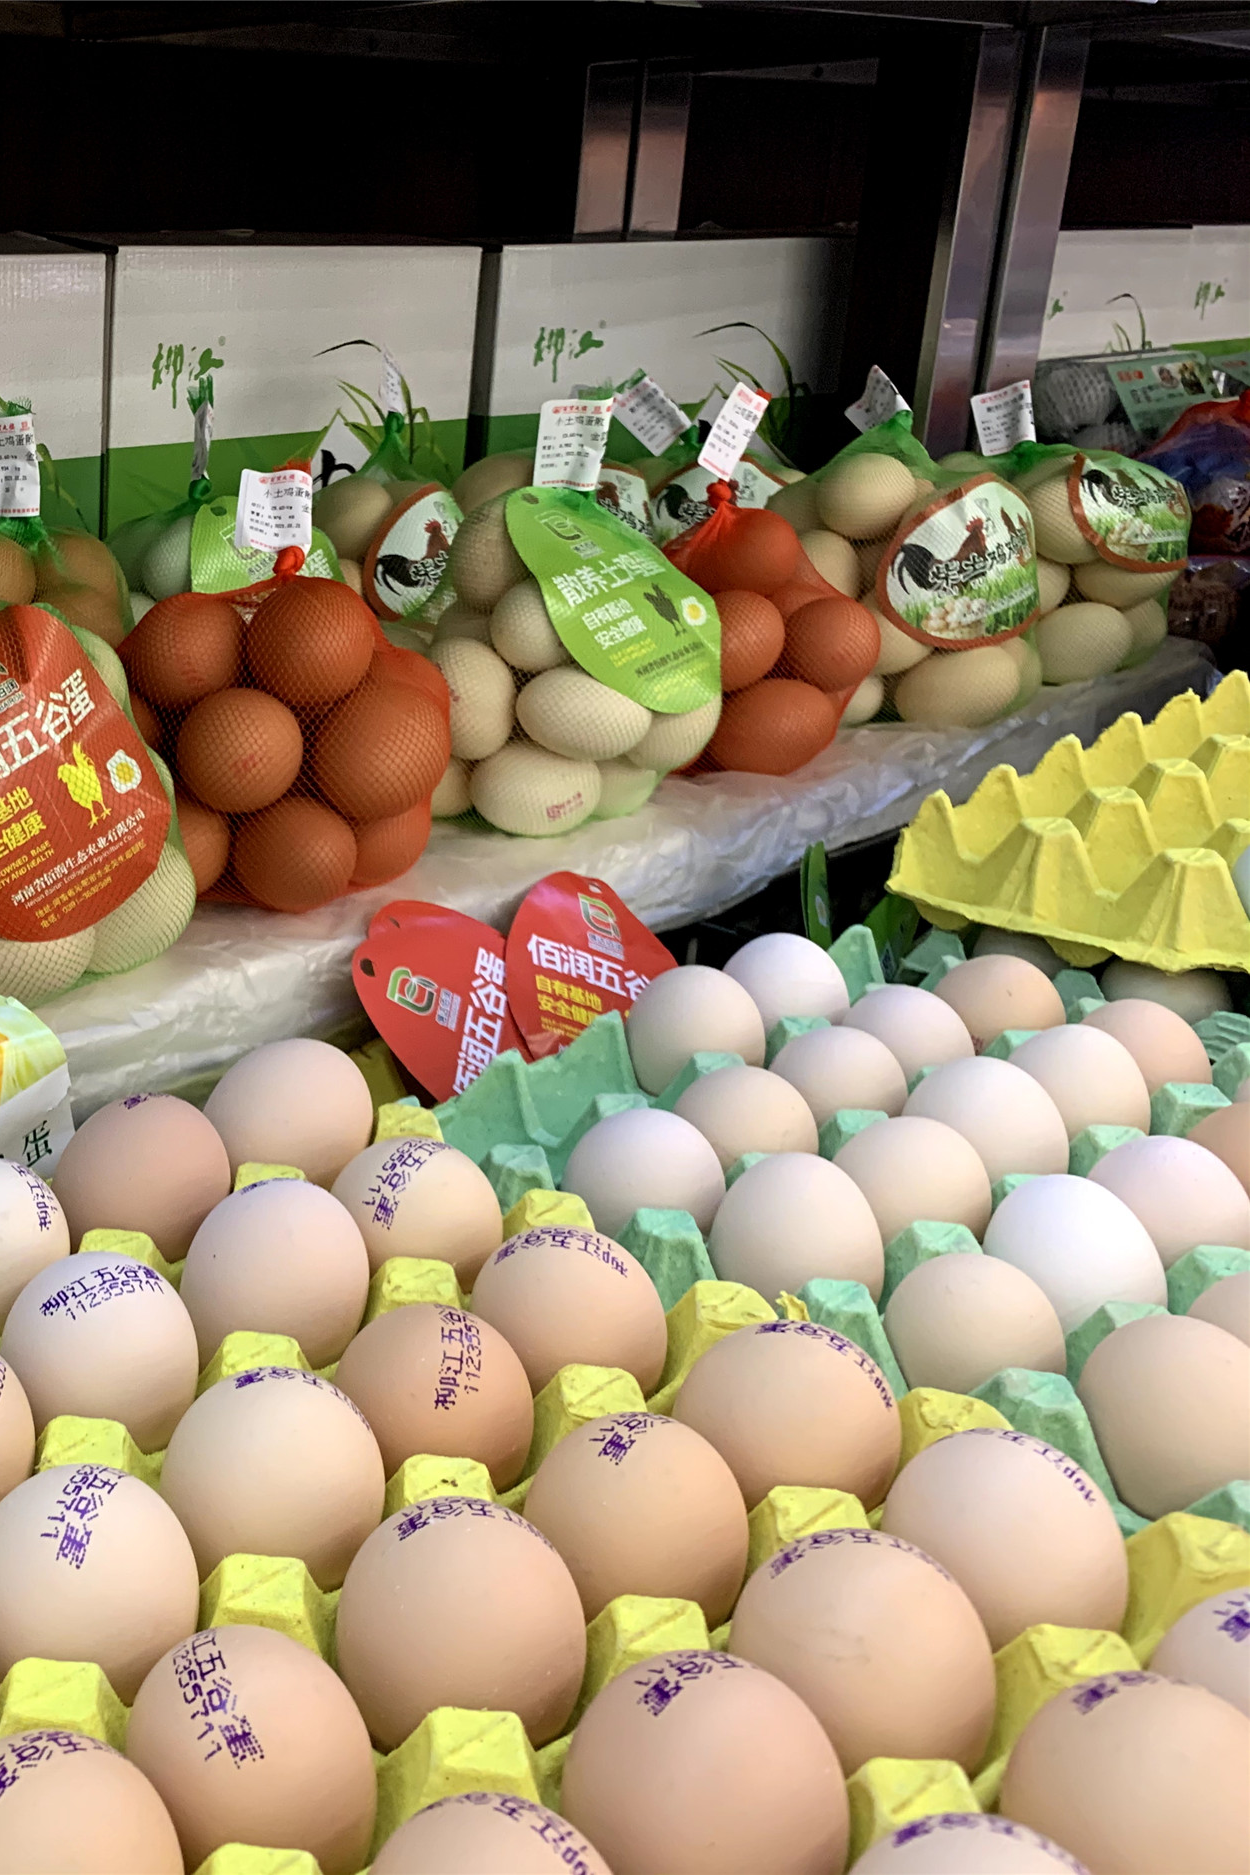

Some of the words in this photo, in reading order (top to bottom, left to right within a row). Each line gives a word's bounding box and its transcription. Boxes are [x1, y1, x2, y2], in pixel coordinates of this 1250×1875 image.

[30, 839, 52, 858] BASE
[534, 975, 603, 1012] 自有基地
[21, 1119, 53, 1168] 蛋
[493, 1230, 629, 1279] 柳江五谷蛋
[38, 1263, 164, 1317] 柳江五谷蛋
[65, 1278, 165, 1321] 112355711
